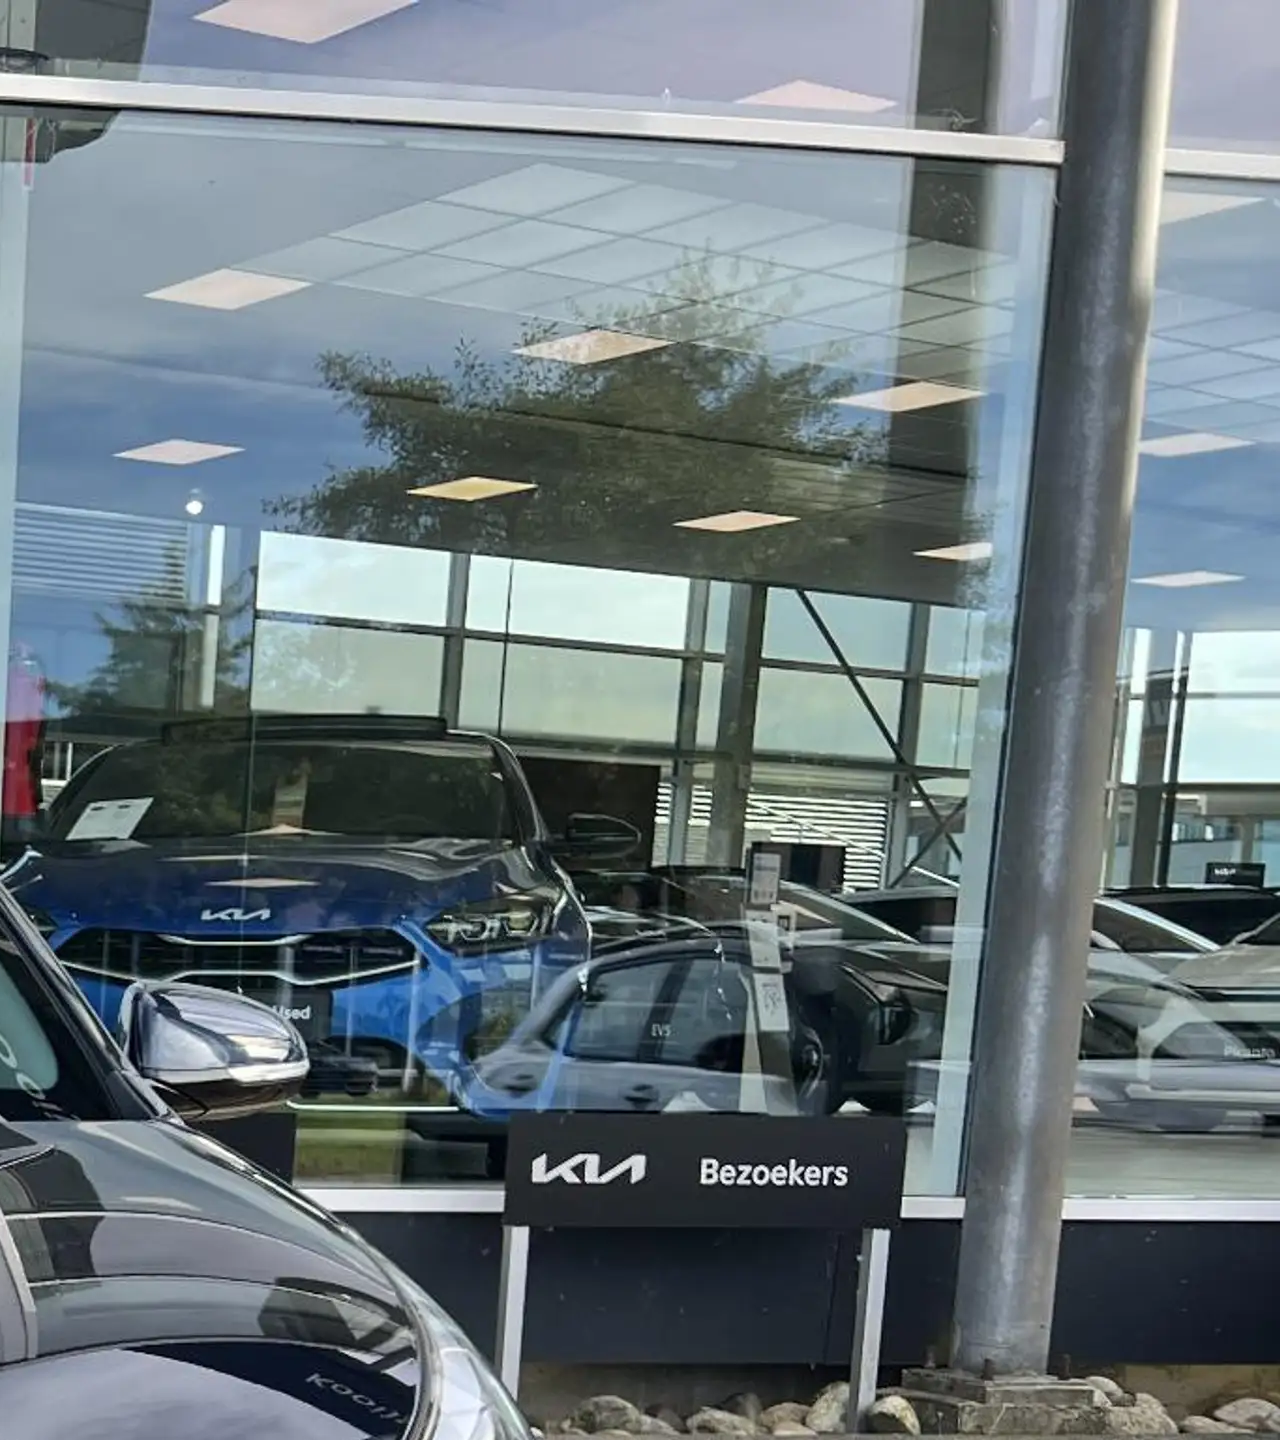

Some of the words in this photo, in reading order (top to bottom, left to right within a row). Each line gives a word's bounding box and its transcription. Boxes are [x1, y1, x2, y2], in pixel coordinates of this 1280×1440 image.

[200, 907, 271, 921] KIA
[531, 1153, 646, 1185] KIA
[699, 1158, 849, 1187] Bezoekers
